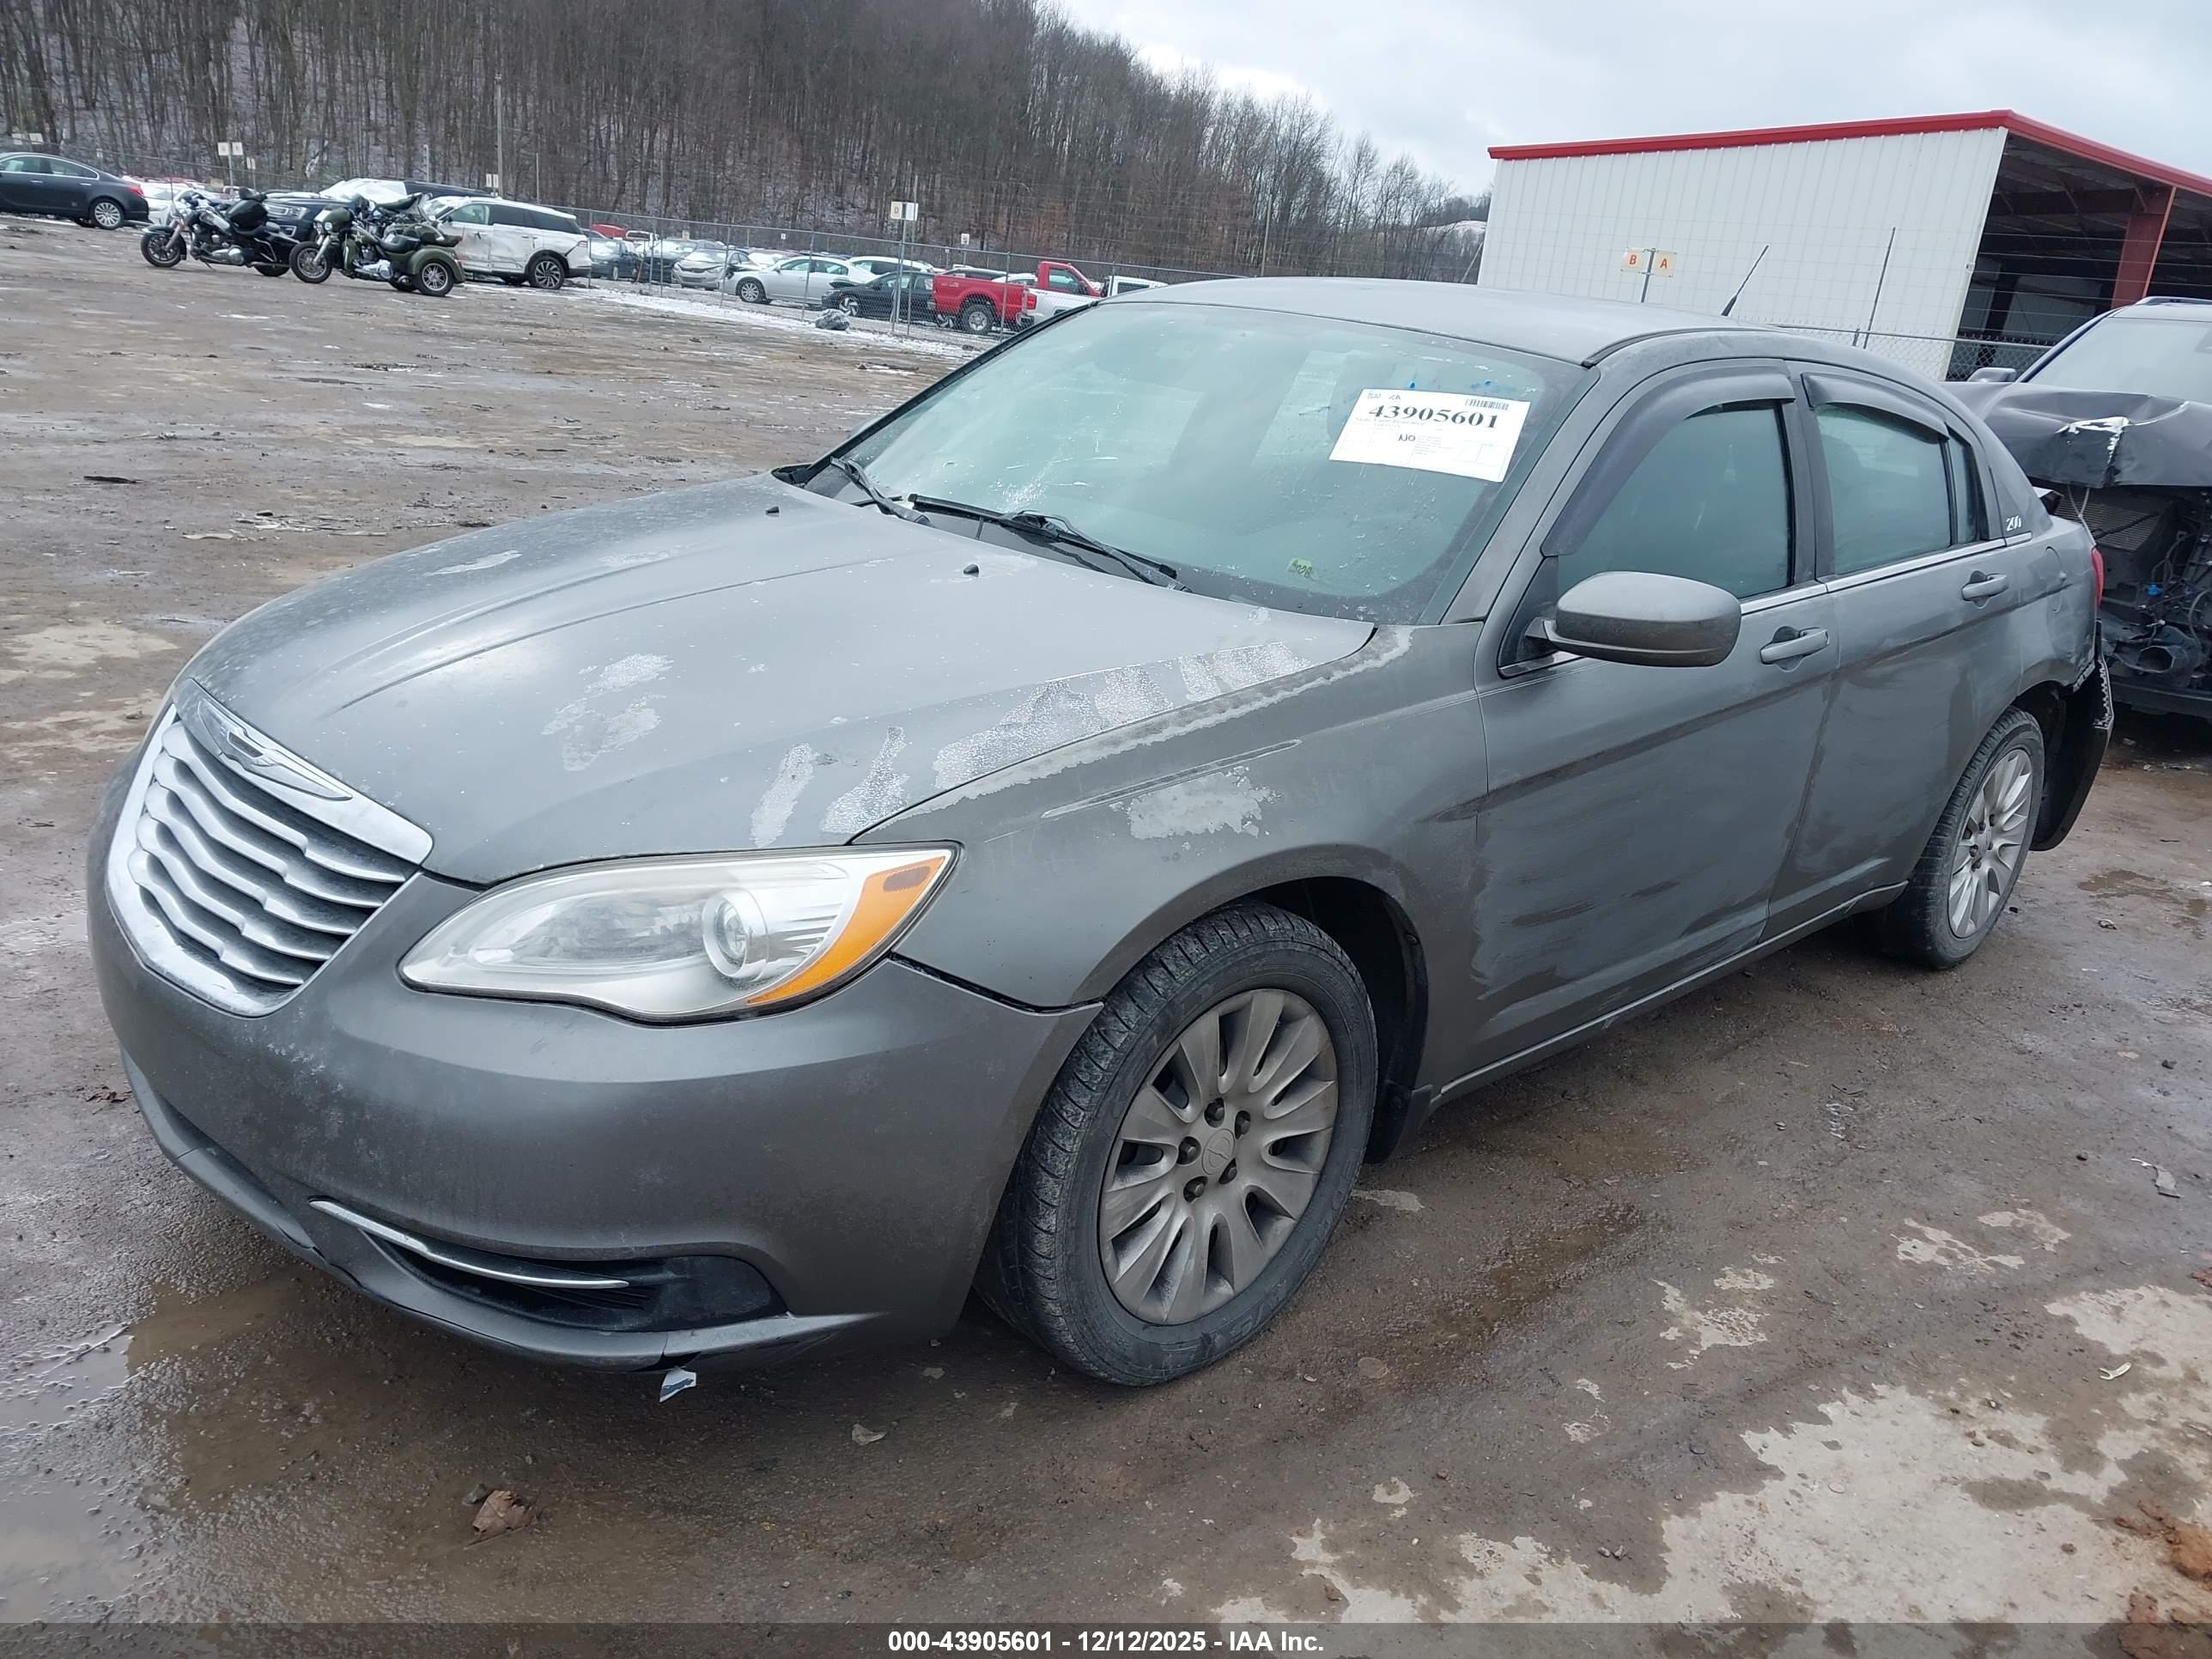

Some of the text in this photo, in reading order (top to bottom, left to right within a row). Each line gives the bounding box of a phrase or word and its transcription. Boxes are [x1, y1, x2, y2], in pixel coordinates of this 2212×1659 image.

[1629, 254, 1637, 265] B
[1660, 258, 1668, 269] A
[1369, 404, 1498, 428] 43905601
